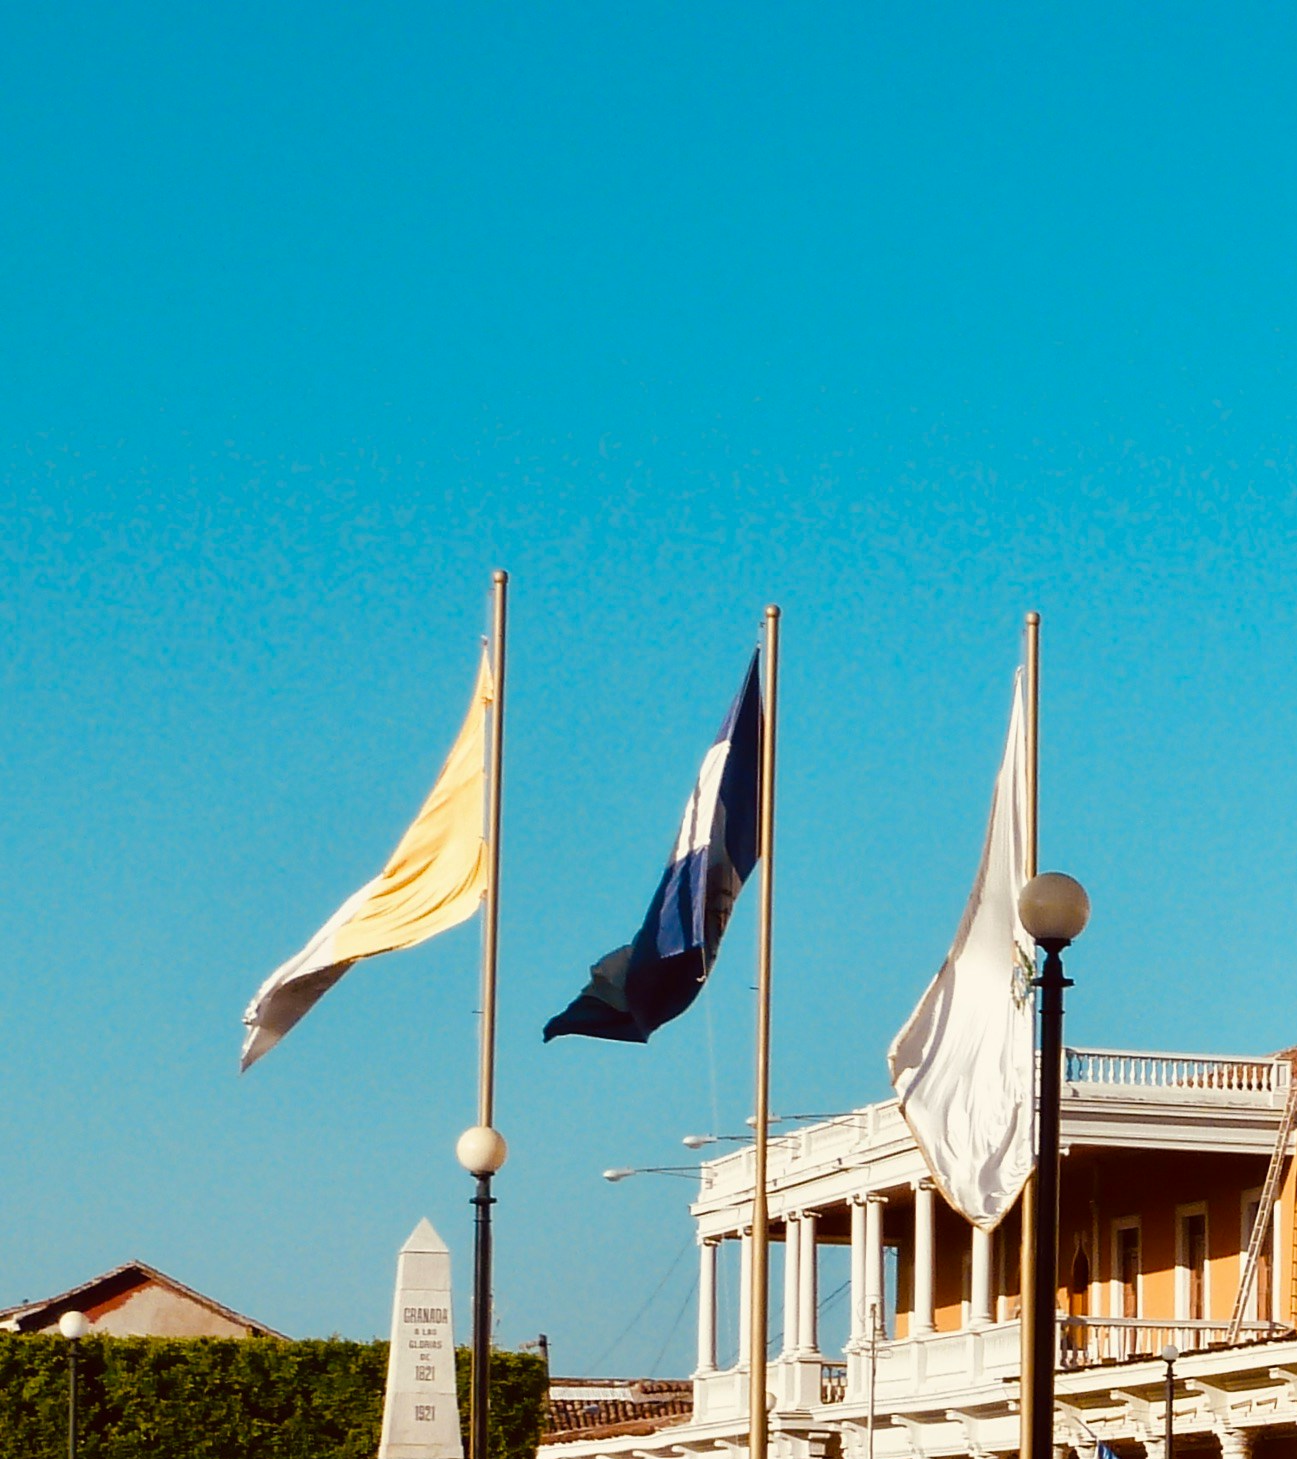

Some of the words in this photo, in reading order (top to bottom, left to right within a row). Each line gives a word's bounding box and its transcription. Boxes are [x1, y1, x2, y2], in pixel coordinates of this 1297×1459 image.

[404, 1308, 448, 1324] GRANADA
[409, 1340, 442, 1349] GLORIAS
[415, 1365, 435, 1381] 1821
[415, 1405, 435, 1421] 1921
